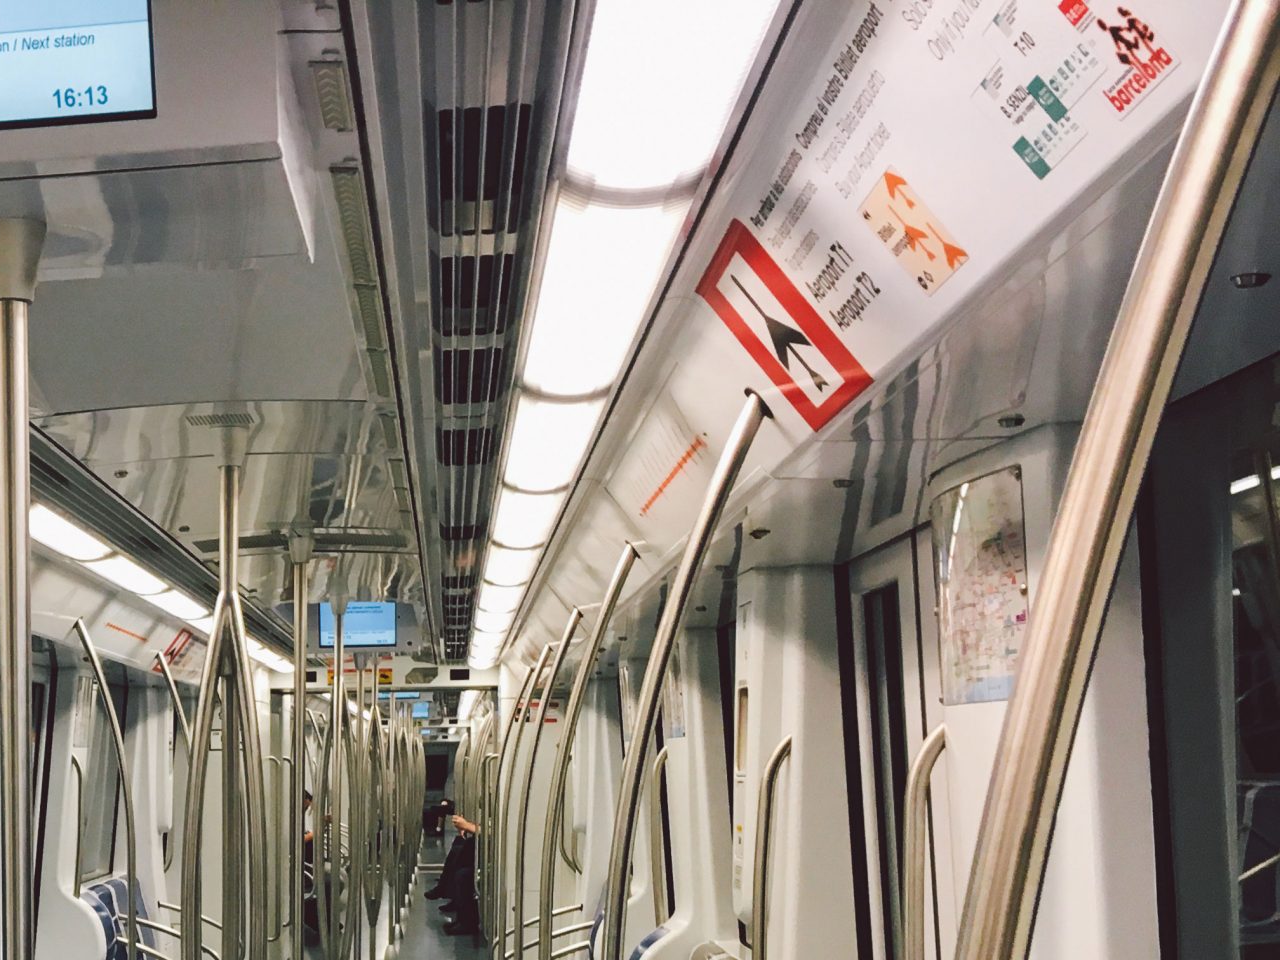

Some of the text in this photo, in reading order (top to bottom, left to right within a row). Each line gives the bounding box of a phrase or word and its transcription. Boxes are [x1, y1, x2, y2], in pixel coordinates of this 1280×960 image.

[21, 34, 50, 51] Next
[53, 31, 95, 48] station
[822, 74, 844, 106] vostre
[852, 1, 884, 54] aeroport
[1013, 31, 1036, 57] T-10
[52, 85, 109, 109] 16:13
[1102, 47, 1173, 113] barcelona
[805, 240, 854, 303] Aeroport T1
[829, 271, 881, 331] Aeroport T2
